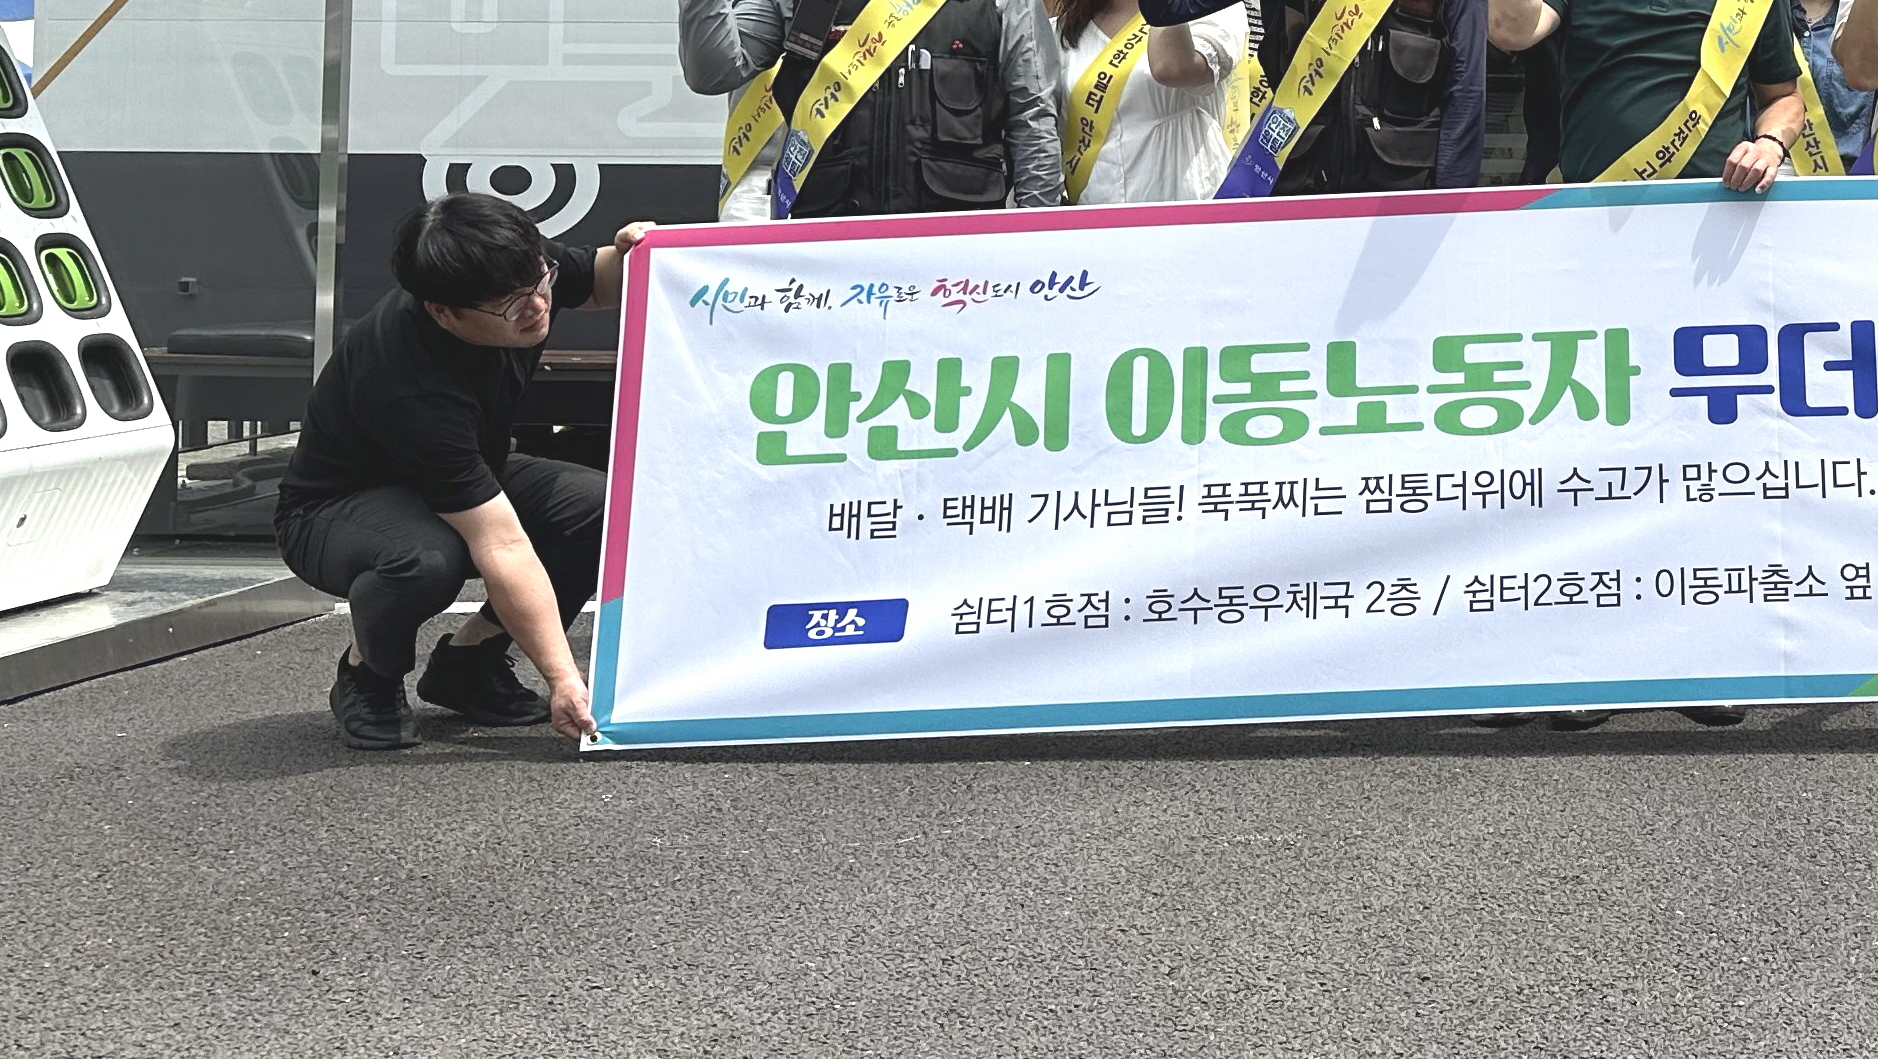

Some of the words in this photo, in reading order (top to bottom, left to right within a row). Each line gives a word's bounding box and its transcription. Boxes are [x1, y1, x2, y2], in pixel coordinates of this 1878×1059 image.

[809, 81, 842, 120] 안산
[1085, 71, 1114, 114] 일터
[1298, 57, 1324, 98] 안산
[1633, 110, 1701, 181] 안전하고
[689, 278, 771, 325] 시민과
[840, 283, 921, 319] 자유로운
[931, 279, 1020, 314] 혁신도시
[1029, 269, 1101, 301] 안산
[749, 352, 1072, 467] 안산시
[1105, 327, 1642, 447] 이동노동자
[828, 498, 904, 541] 배달
[942, 492, 1013, 536] 택배
[1027, 484, 1185, 531] 기사님들!
[1197, 477, 1347, 522] 푹푹찌는
[1358, 467, 1543, 514] 찜통더위에
[1556, 463, 1670, 507] 수고가
[1682, 457, 1876, 503] 많으십니다.
[803, 604, 868, 642] 장소
[950, 590, 1110, 635] 쉼터1호점
[1142, 581, 1355, 625] 호수동우체국
[1365, 577, 1422, 617] 2층
[1463, 569, 1621, 613] 쉼터2호점
[1655, 563, 1829, 606] 이동파출소
[1840, 562, 1873, 601] 옆
